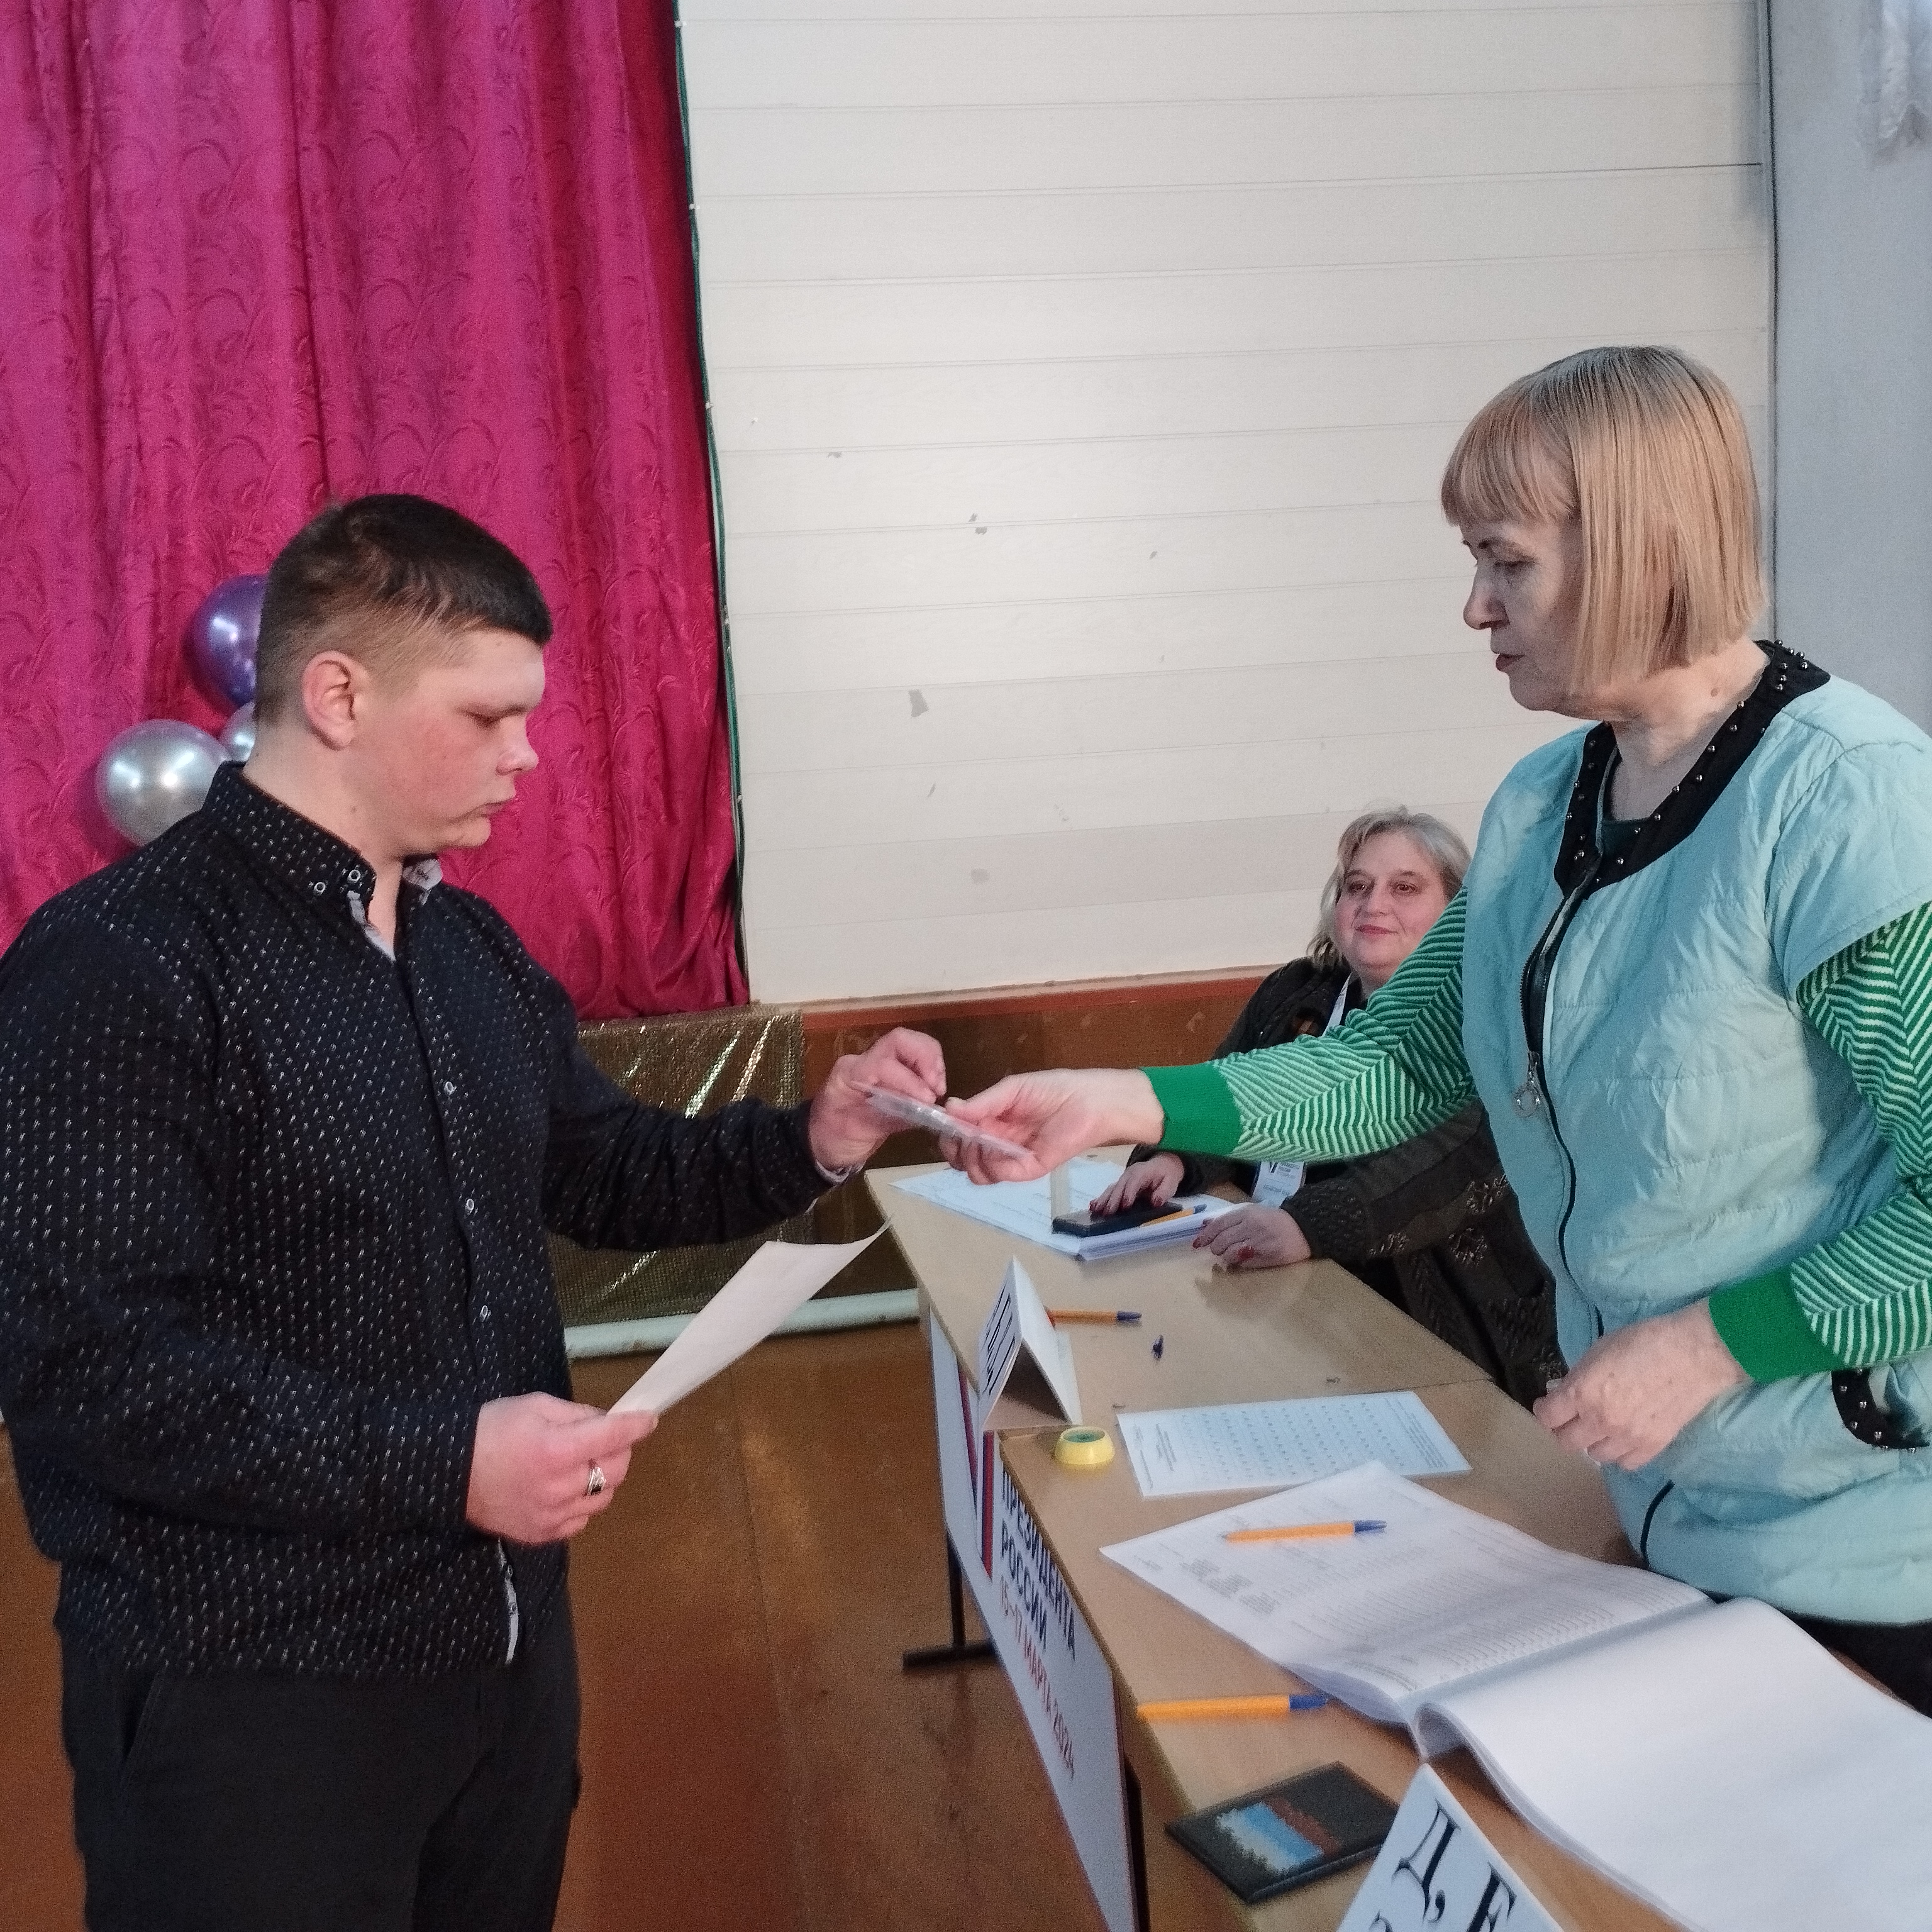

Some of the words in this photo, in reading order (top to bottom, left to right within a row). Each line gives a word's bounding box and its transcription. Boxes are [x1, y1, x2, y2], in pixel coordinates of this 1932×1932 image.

[1001, 1517, 1046, 1652] РОССИИ
[1002, 1463, 1075, 1662] ПРЕЗИДЕНТА
[1024, 1624, 1052, 1719] МАРТА
[1053, 1698, 1075, 1780] 2024
